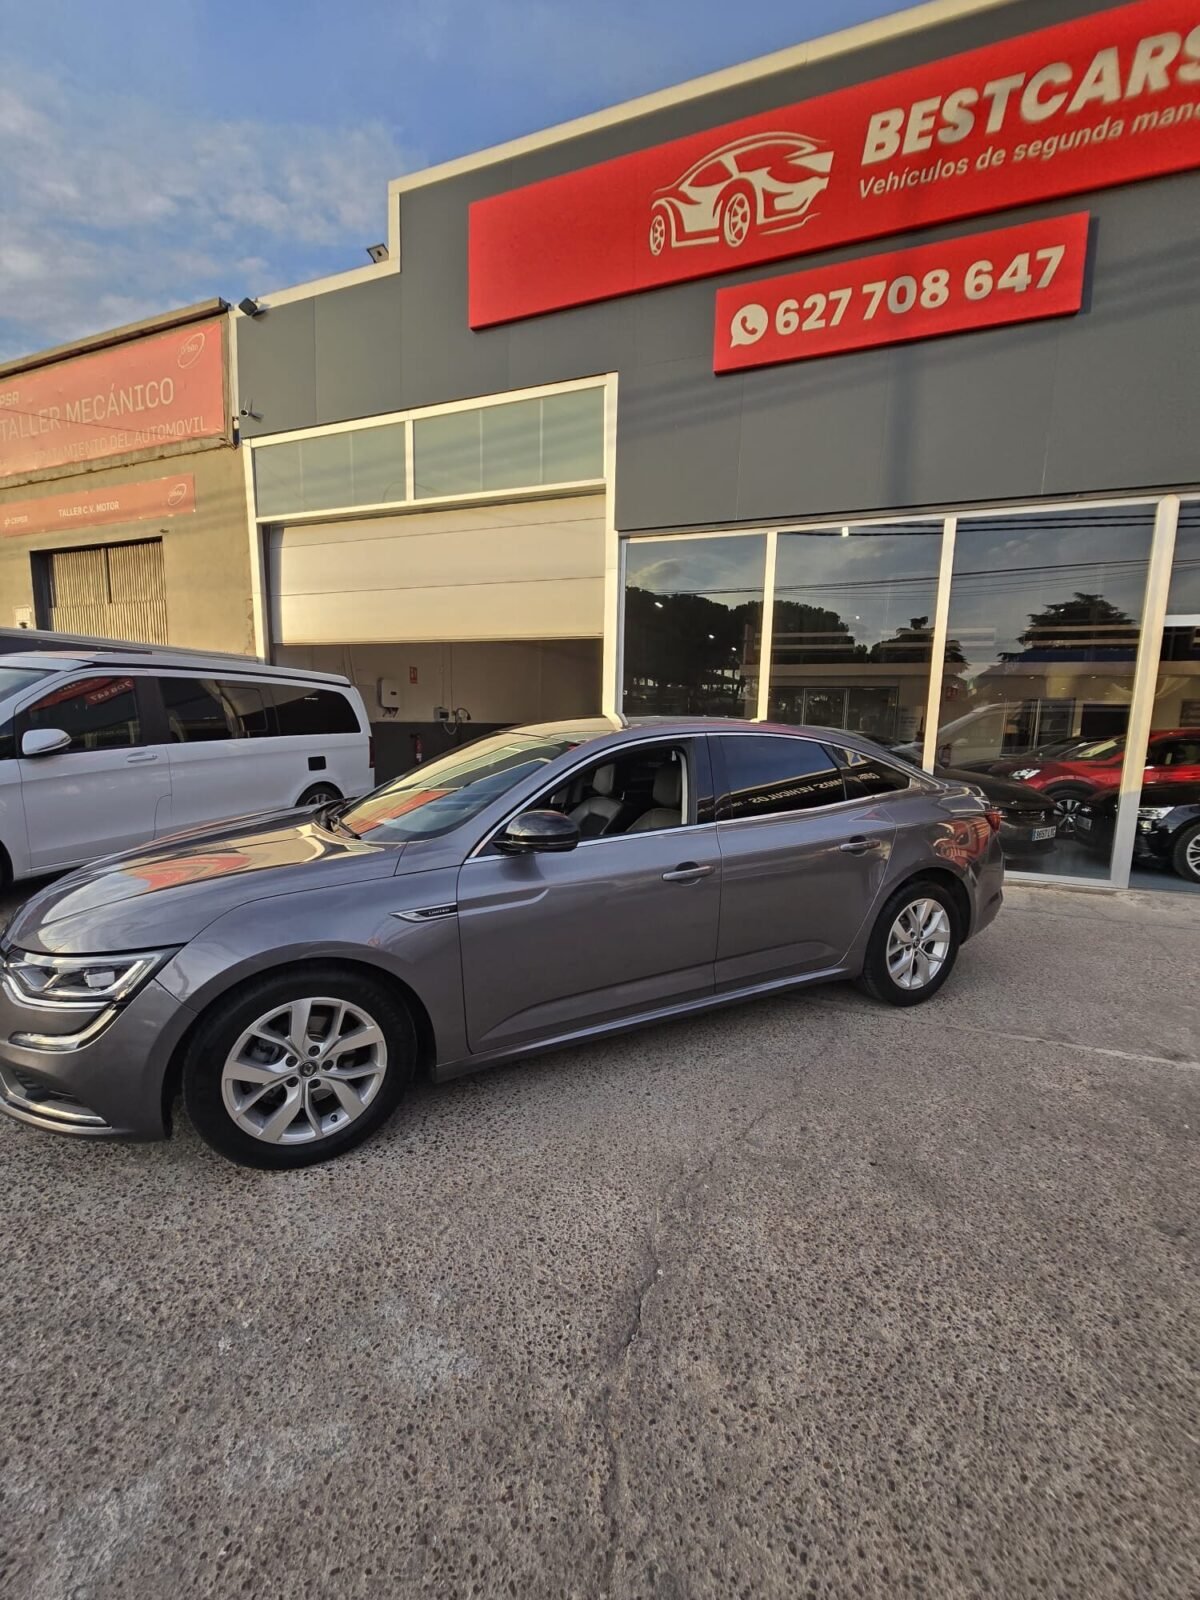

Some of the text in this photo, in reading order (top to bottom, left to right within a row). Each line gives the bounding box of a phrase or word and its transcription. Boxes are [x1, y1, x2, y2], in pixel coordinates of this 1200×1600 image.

[859, 158, 968, 199] Vehículos
[976, 147, 1006, 171] de
[1012, 116, 1125, 160] segunda
[775, 245, 1066, 336] 627 708 647
[0, 377, 174, 442] TALLER MECÁNICO
[110, 431, 132, 449] DEL
[135, 415, 207, 444] AUTOMOVIL
